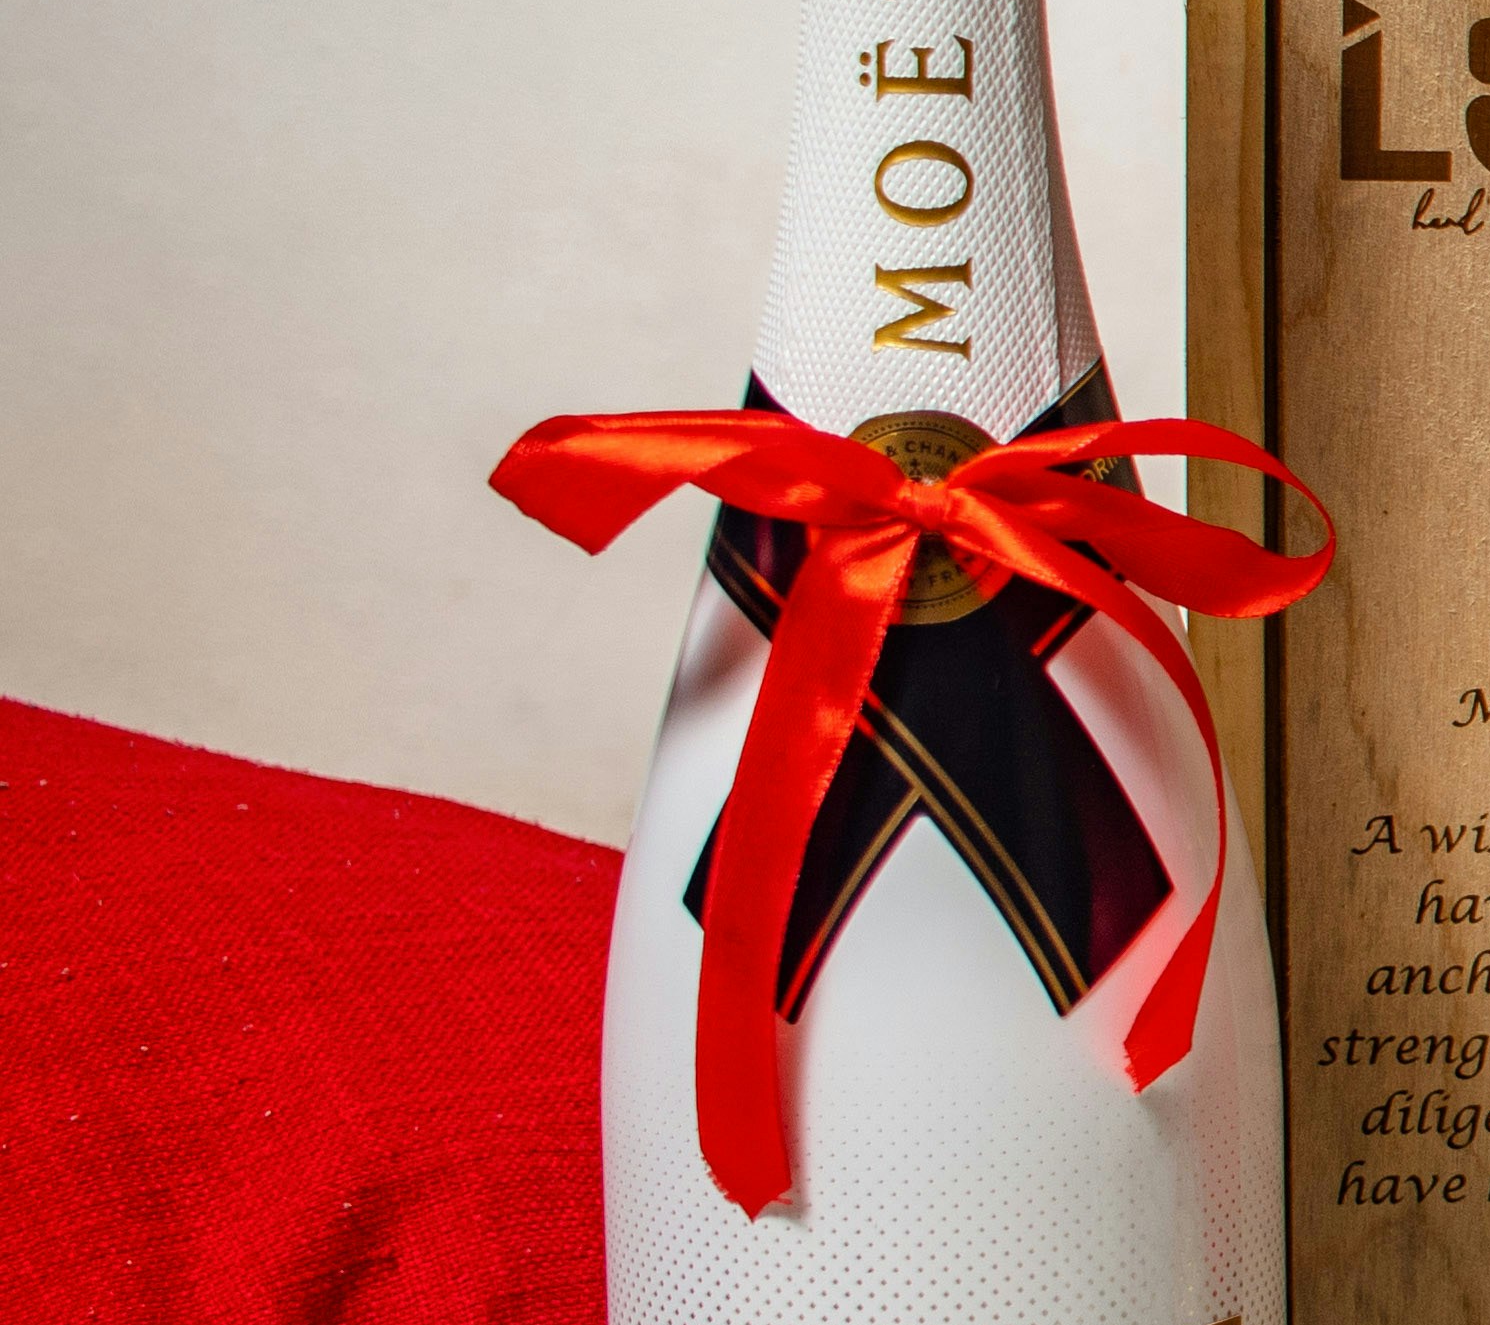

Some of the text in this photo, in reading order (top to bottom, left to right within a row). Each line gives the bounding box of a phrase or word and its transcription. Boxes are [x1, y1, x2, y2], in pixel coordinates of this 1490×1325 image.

[1411, 187, 1487, 235] hand
[1351, 814, 1402, 857] A
[1337, 1160, 1469, 1207] have
